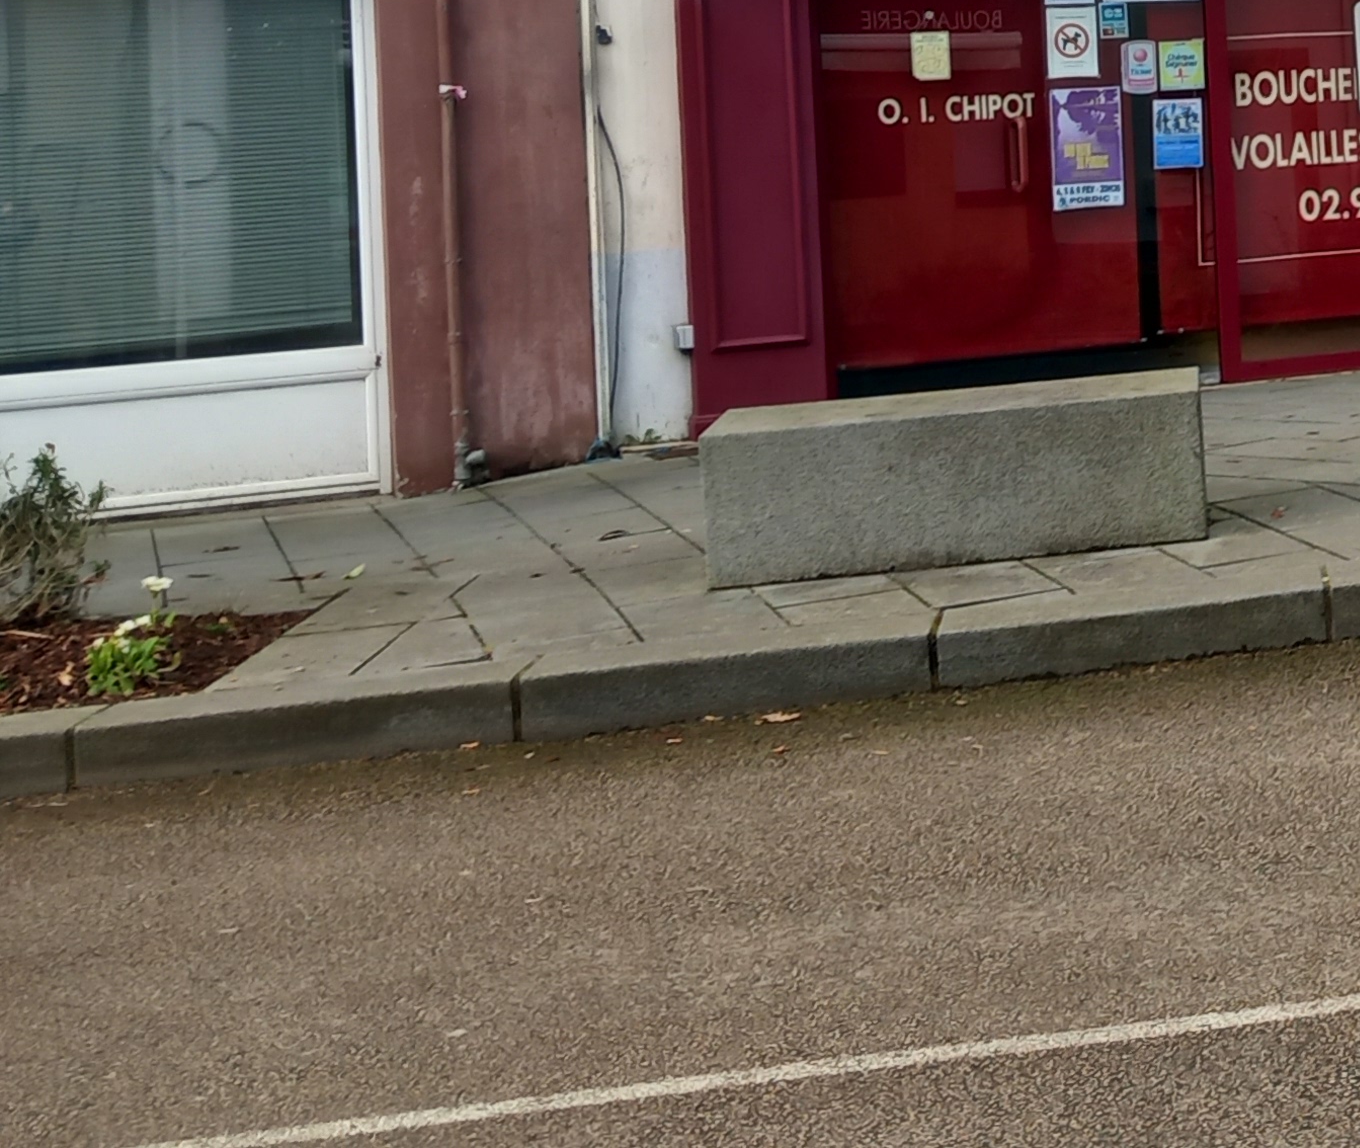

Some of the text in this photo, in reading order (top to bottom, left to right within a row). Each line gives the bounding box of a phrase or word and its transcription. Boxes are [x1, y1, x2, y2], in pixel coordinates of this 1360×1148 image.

[1235, 67, 1358, 107] BOUCHE
[878, 98, 909, 125] O.
[945, 93, 1036, 122] CHIPOT
